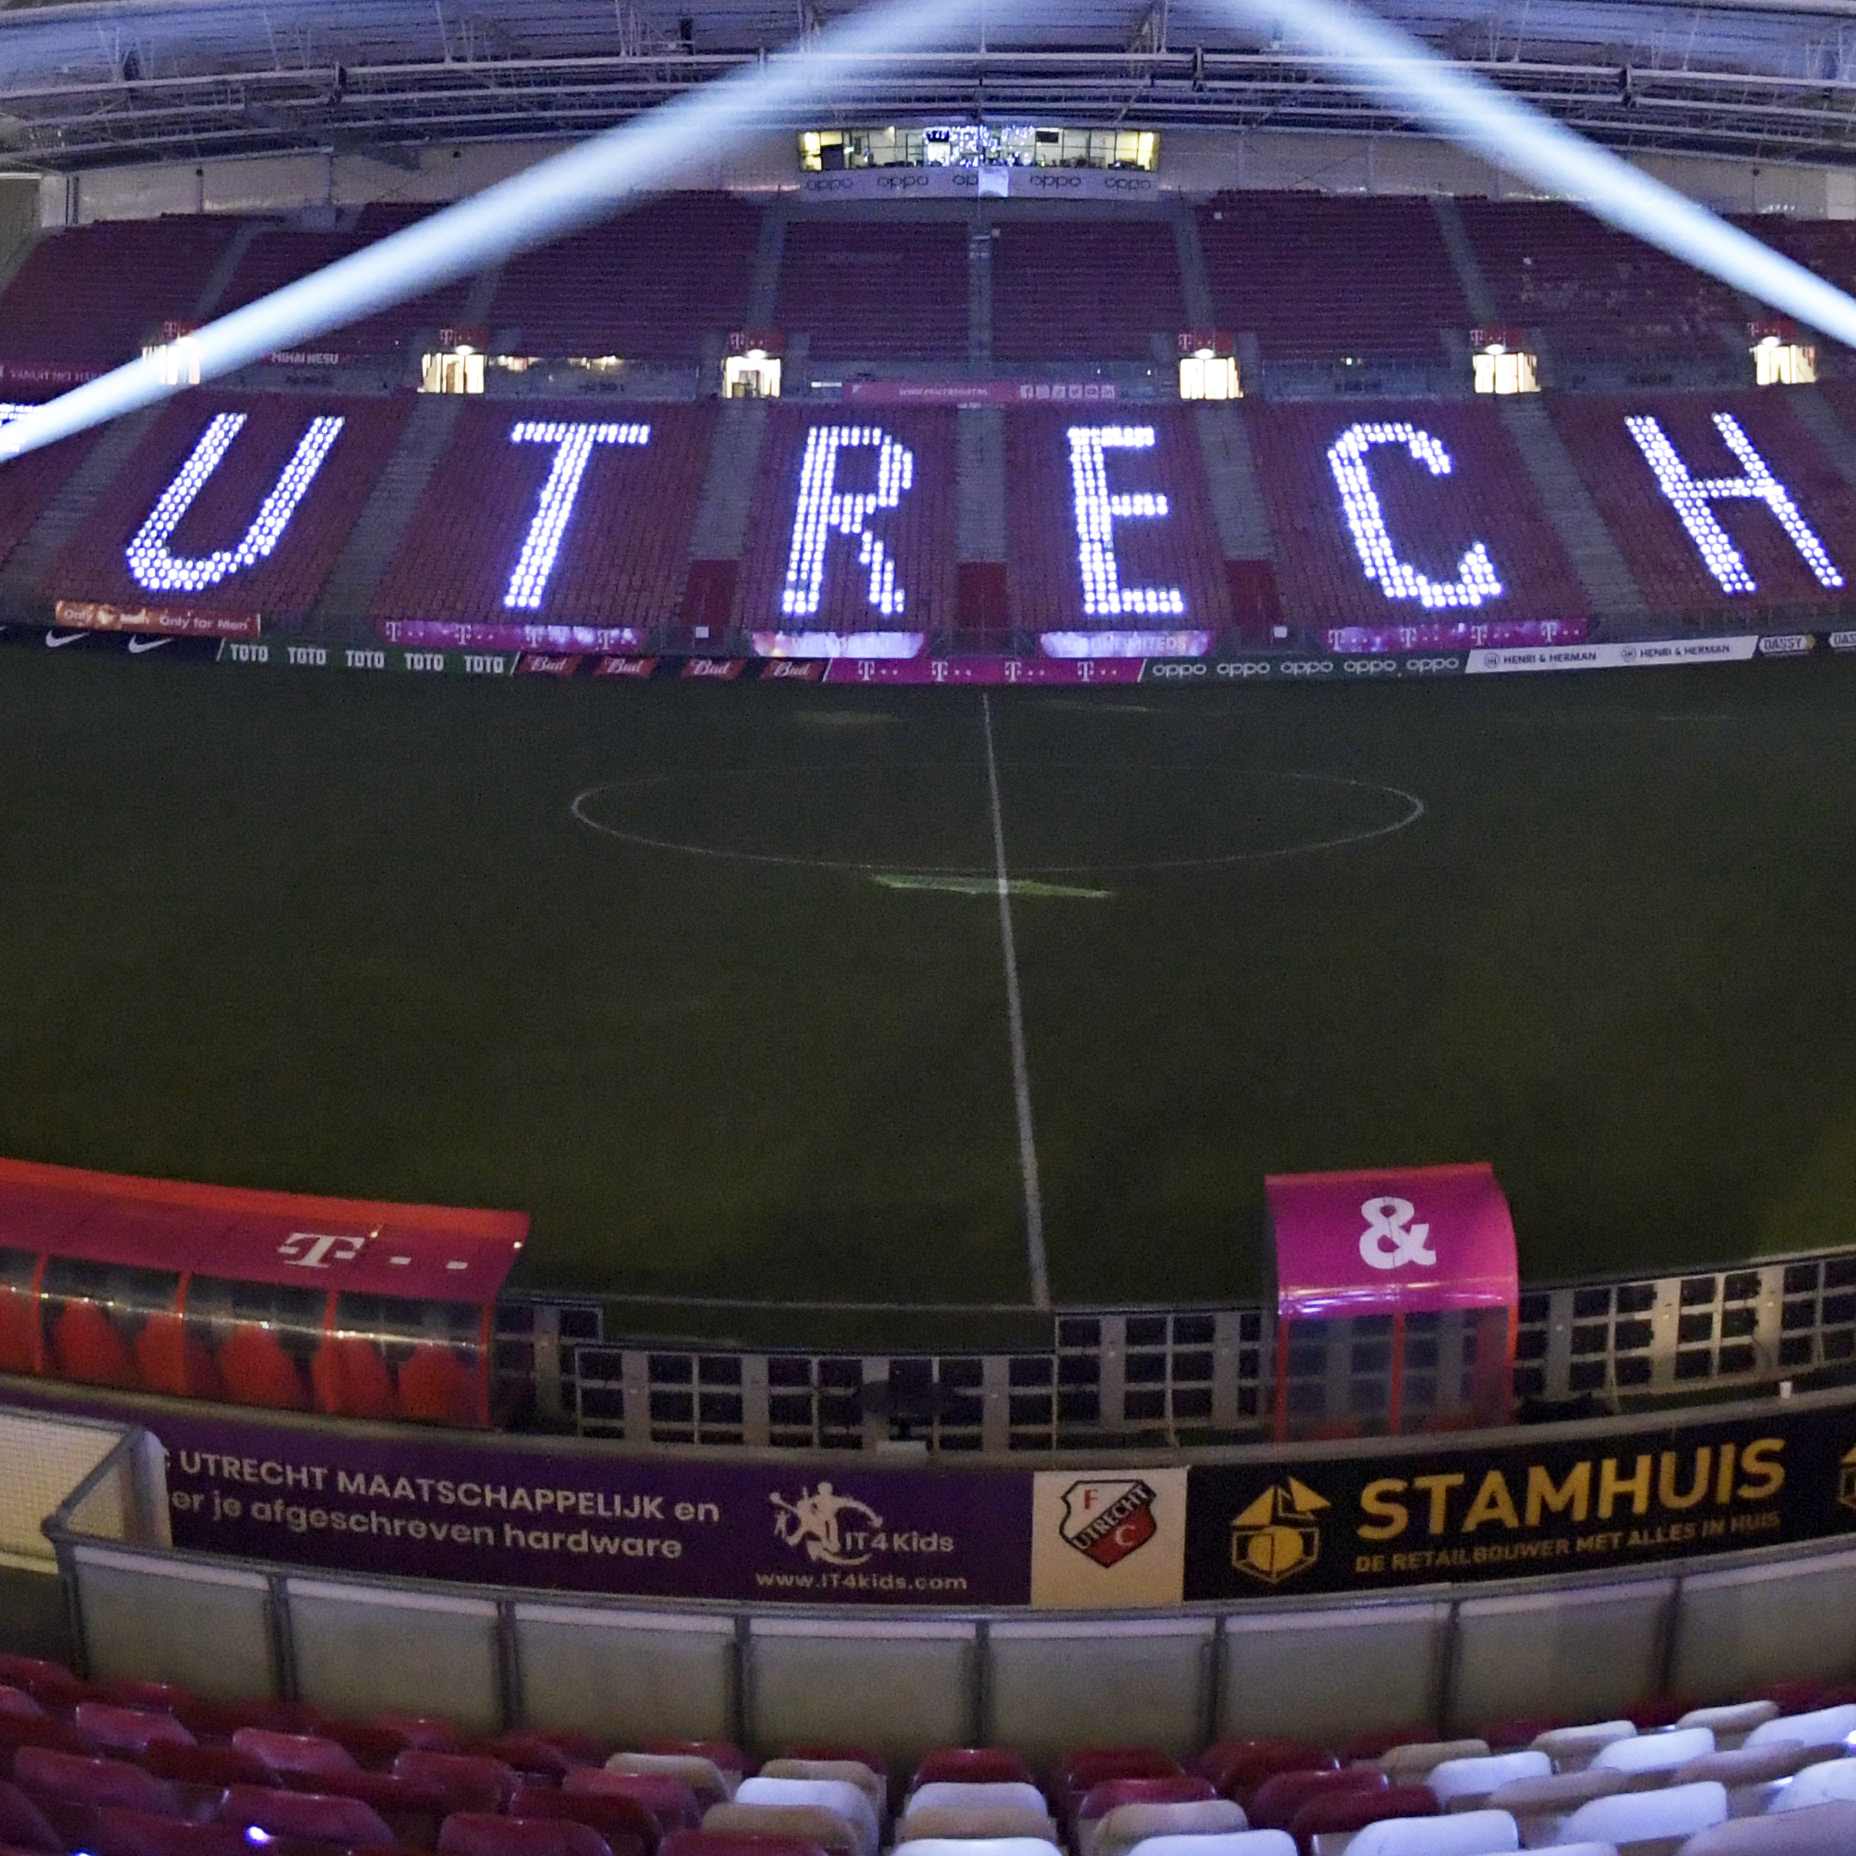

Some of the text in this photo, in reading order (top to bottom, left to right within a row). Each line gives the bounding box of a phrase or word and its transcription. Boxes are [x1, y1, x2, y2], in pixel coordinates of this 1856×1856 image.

[1640, 646, 1672, 659] HENRI
[1684, 643, 1730, 657] HERMAN
[1764, 635, 1804, 653] DASSY
[230, 646, 269, 662] TOTO
[288, 647, 326, 665] TOTO
[345, 649, 384, 668] TOTO
[404, 652, 444, 672] TOTO
[1503, 652, 1535, 665] HENRI
[1549, 650, 1597, 663] HERMAN
[464, 654, 504, 674] TOTO
[530, 656, 566, 673] Bud
[606, 657, 643, 674] Bud
[692, 659, 731, 676] Bud
[774, 660, 811, 677] Bud
[1359, 1196, 1437, 1270] &
[180, 1450, 329, 1491] UTRECHT
[337, 1470, 664, 1521] MAATSCHAPPELIJK
[673, 1500, 721, 1523] en
[1355, 1437, 1787, 1541] STAMHUIS
[169, 1489, 684, 1561] er je afgeschreven hardware
[1073, 1481, 1155, 1553] UTRECHT
[1355, 1553, 1385, 1573] DE
[1575, 1531, 1624, 1553] MET
[1626, 1523, 1697, 1546] ALLES
[1702, 1516, 1726, 1537] IN
